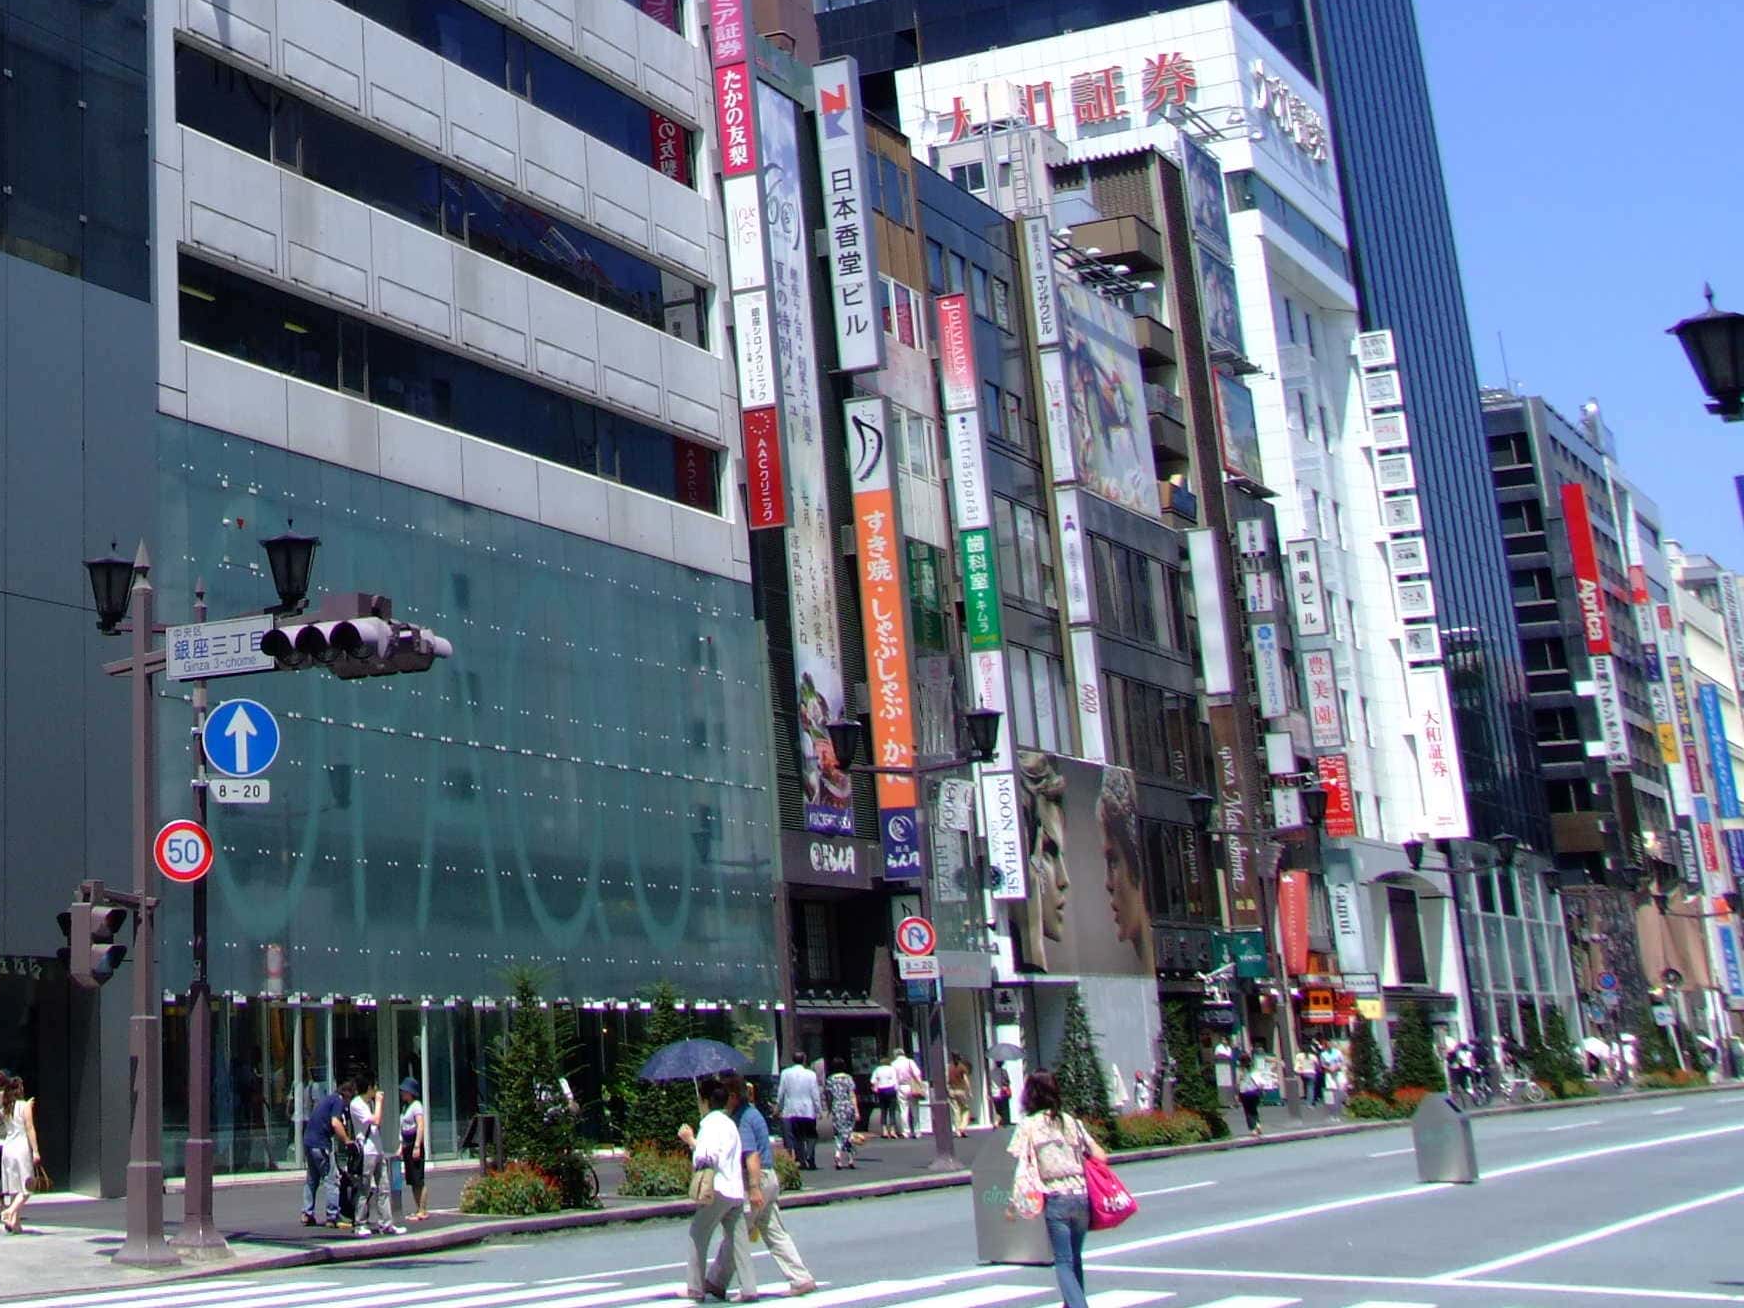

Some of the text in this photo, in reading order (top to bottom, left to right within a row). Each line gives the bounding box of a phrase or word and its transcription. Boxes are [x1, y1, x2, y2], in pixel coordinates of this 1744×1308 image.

[721, 69, 750, 168] たかの友梨
[829, 167, 869, 337] 日本香堂ビル
[757, 437, 773, 521] AACクリニック
[173, 626, 203, 638] 中央区
[1579, 578, 1606, 641] Aprica
[174, 630, 266, 662] 銀座三丁目
[183, 655, 257, 673] Ginza 3-chome
[167, 839, 200, 865] 50
[997, 777, 1021, 895] MOON PHASE
